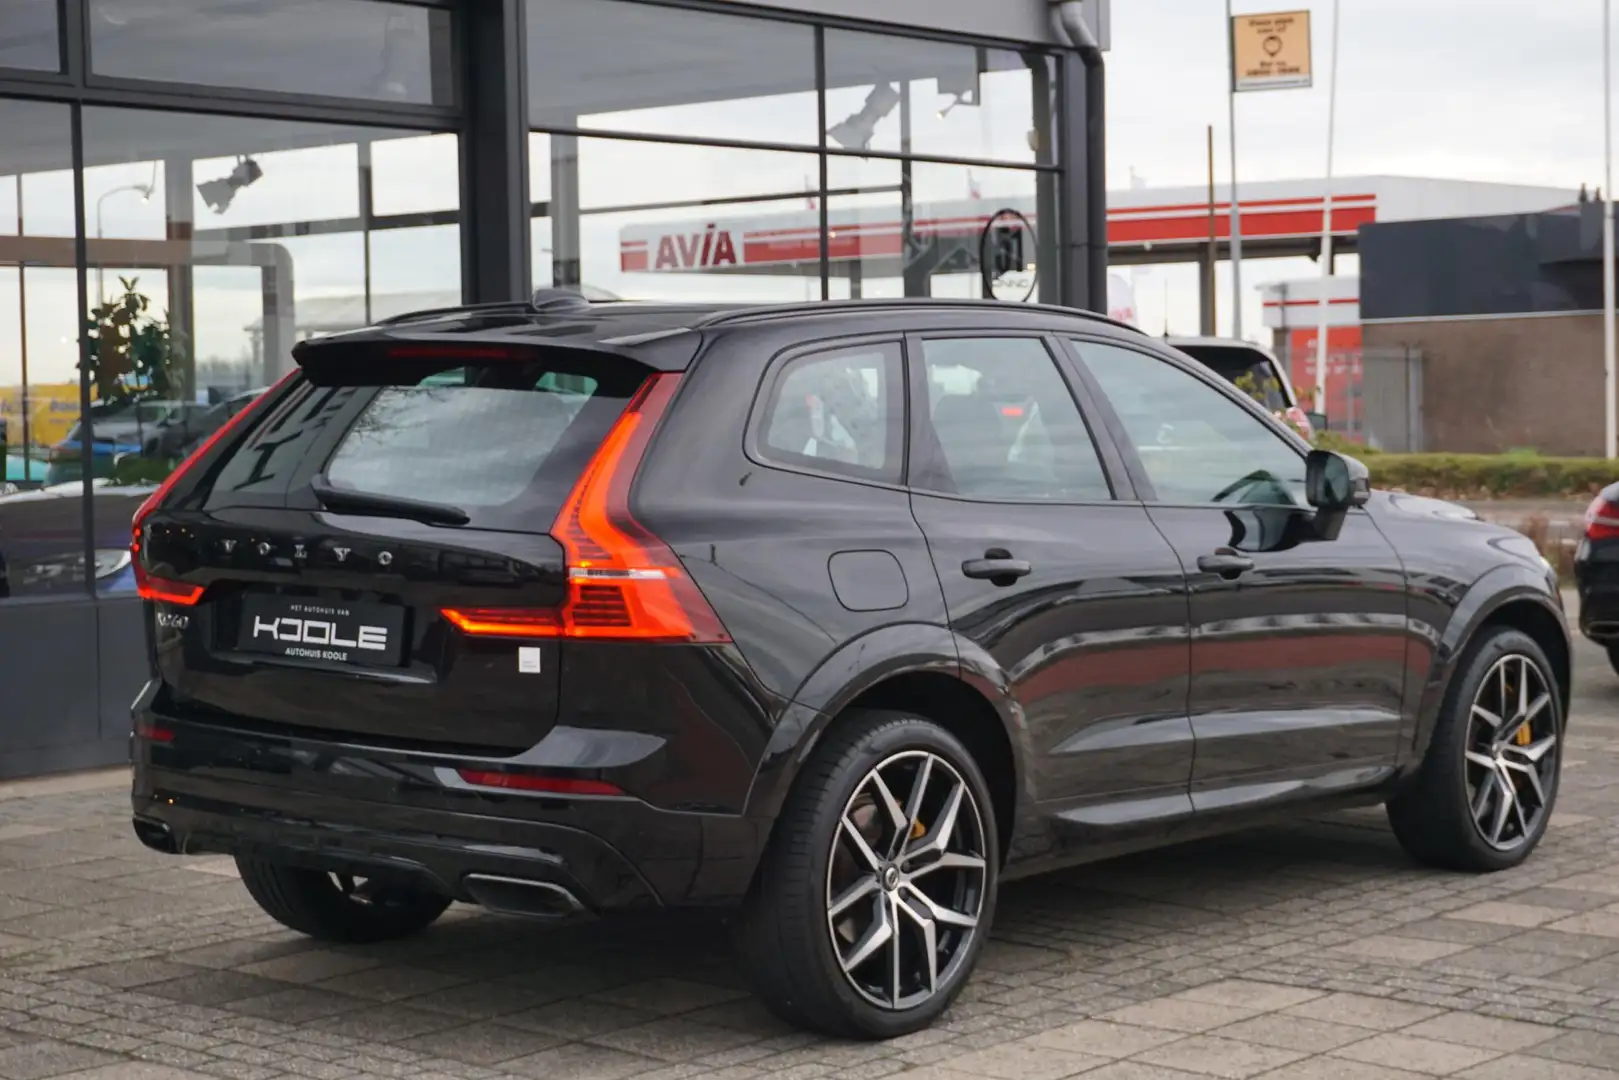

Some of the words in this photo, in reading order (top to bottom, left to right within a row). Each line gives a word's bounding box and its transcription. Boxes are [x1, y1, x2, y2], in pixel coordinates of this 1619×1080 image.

[221, 539, 394, 566] VOLVO
[253, 615, 388, 651] KOOLE
[284, 647, 322, 659] AUTOHUIS
[322, 650, 348, 661] KOOLE
